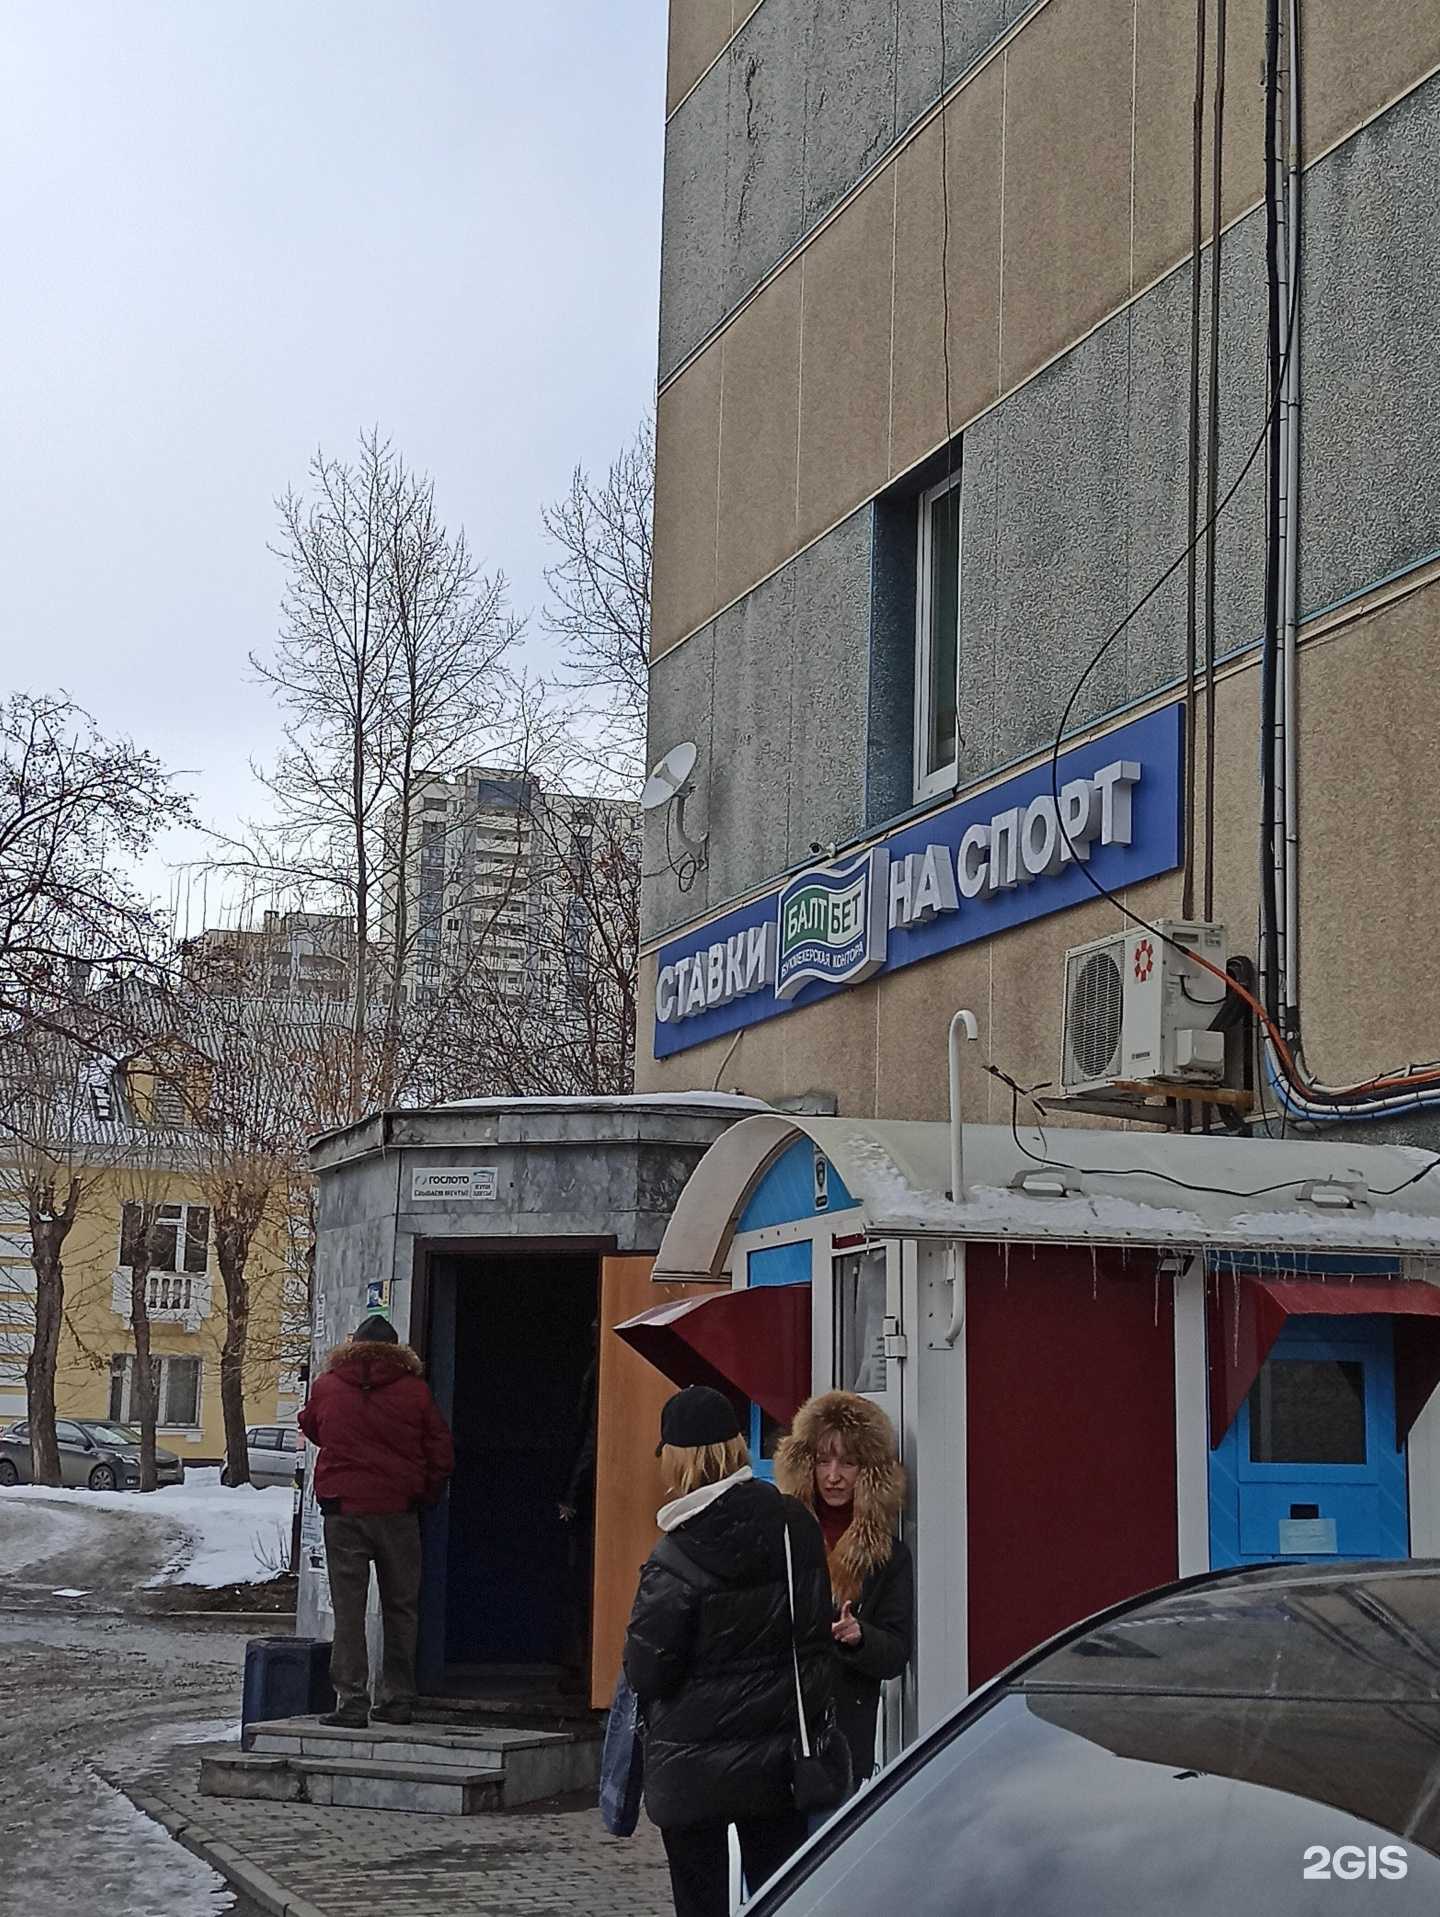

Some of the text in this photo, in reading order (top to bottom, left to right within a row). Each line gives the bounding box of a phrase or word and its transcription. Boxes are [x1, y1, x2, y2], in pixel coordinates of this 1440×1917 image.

[656, 760, 1142, 1022] СТАВКИ НА СПОРТ
[781, 941, 863, 977] БУКМЕКЕРСКАЯ КОНТОРА
